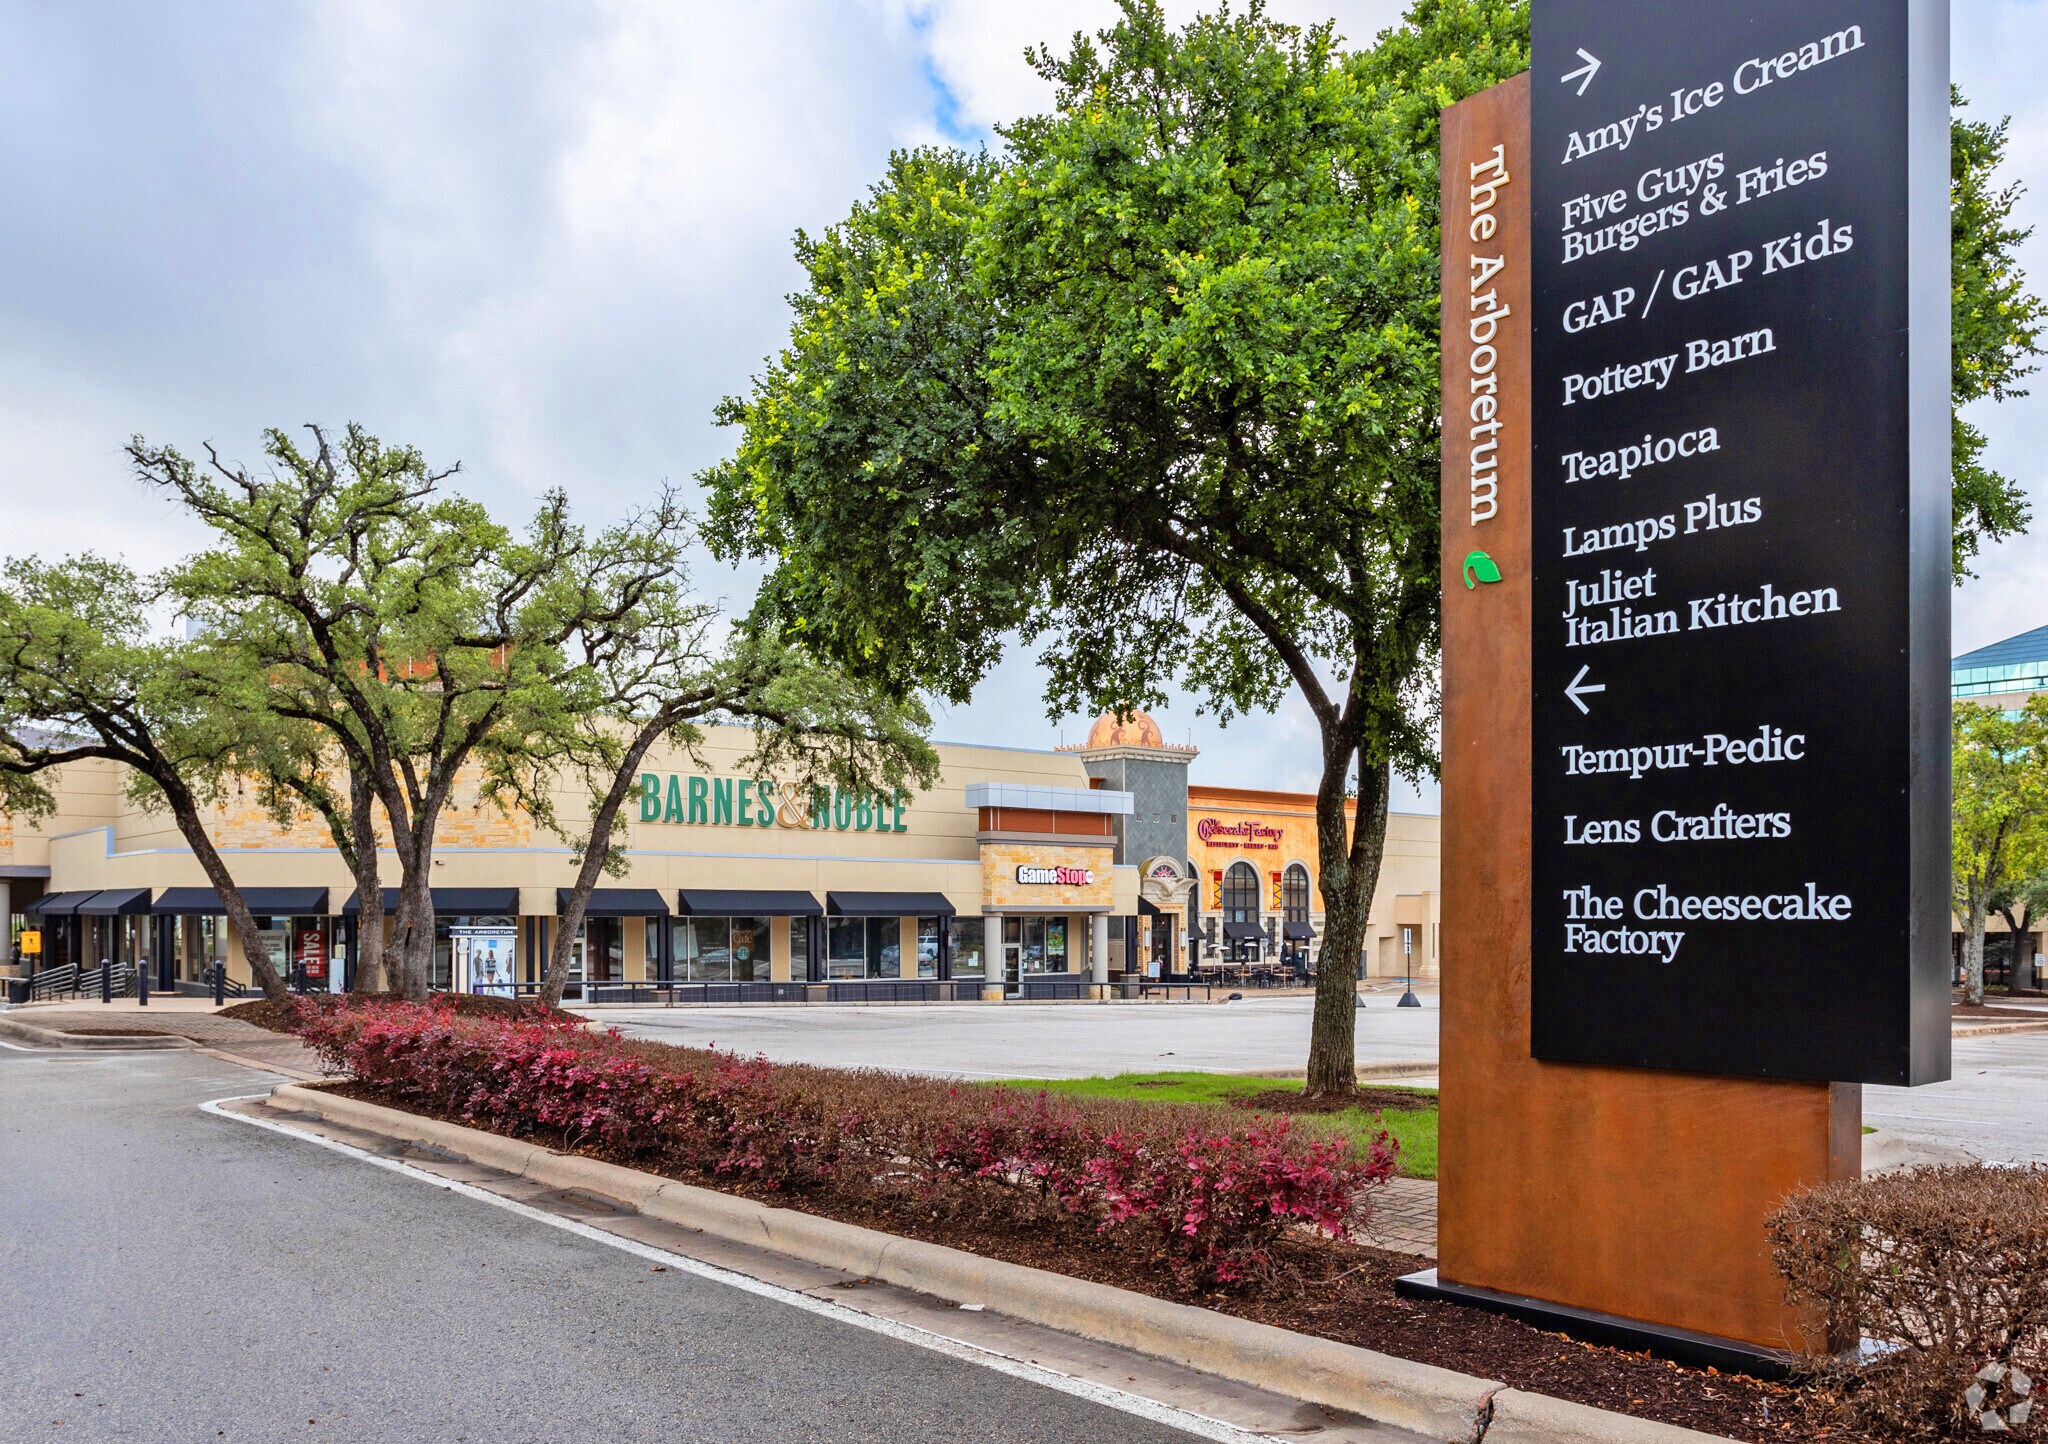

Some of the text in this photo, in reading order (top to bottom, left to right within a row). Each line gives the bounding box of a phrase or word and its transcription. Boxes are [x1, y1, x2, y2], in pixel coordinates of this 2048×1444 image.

[1561, 24, 1866, 165] Amy's Ice Cream
[1561, 152, 1725, 232] Five Guys
[1561, 150, 1828, 264] Burgers & Fries
[1562, 286, 1636, 334] GAP
[1672, 250, 1753, 301] GAP
[1761, 218, 1854, 276] Kids
[1470, 144, 1511, 527] The Arboretum
[1562, 328, 1777, 406] Pottery Barn
[1561, 427, 1721, 484] Teapioca
[1562, 492, 1762, 558] Lamps Plus
[1562, 567, 1657, 619] Juliet
[1565, 583, 1842, 647] Italian Kitchen
[1561, 724, 1805, 780] Tempur-Pedic
[640, 773, 775, 828] BARNES
[775, 781, 812, 829] &
[1563, 802, 1792, 845] Lens Crafters
[1198, 818, 1249, 842] Cheesecake
[1244, 821, 1284, 842] Factory
[1016, 865, 1087, 886] GameStop
[1563, 882, 1852, 921] The Cheesecake
[303, 933, 320, 965] SALE
[1563, 923, 1686, 964] Factory
